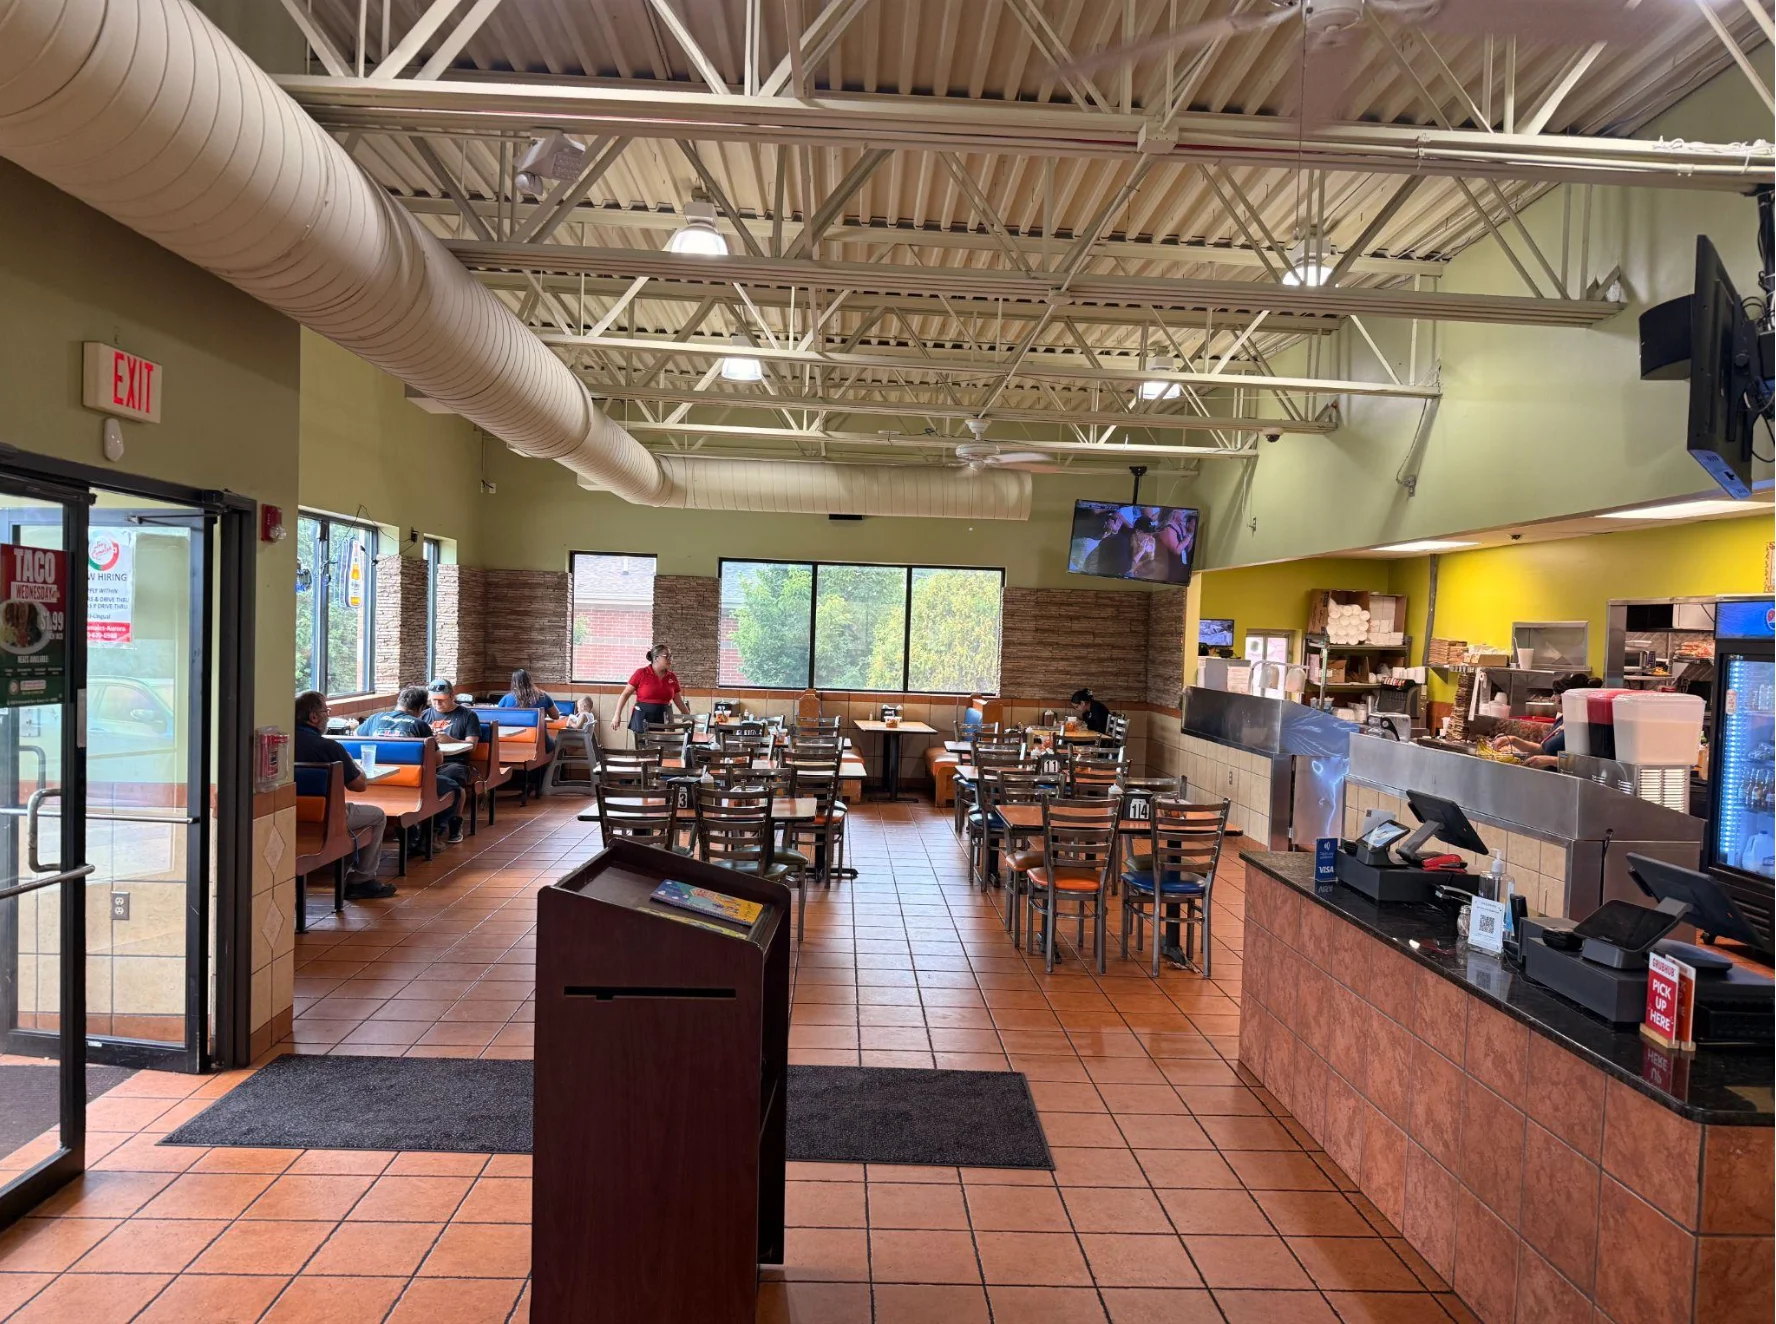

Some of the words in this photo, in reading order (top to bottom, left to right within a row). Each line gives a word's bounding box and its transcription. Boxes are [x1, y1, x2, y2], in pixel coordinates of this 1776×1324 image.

[114, 351, 154, 413] EXIT
[14, 548, 56, 584] TACO
[98, 573, 127, 581] HIRING
[1045, 760, 1058, 772] 11
[1131, 803, 1148, 819] 14
[1652, 957, 1675, 977] GRUBHUB
[1652, 979, 1671, 1000] PICK
[1655, 996, 1667, 1012] UP
[1650, 1009, 1670, 1032] HERE
